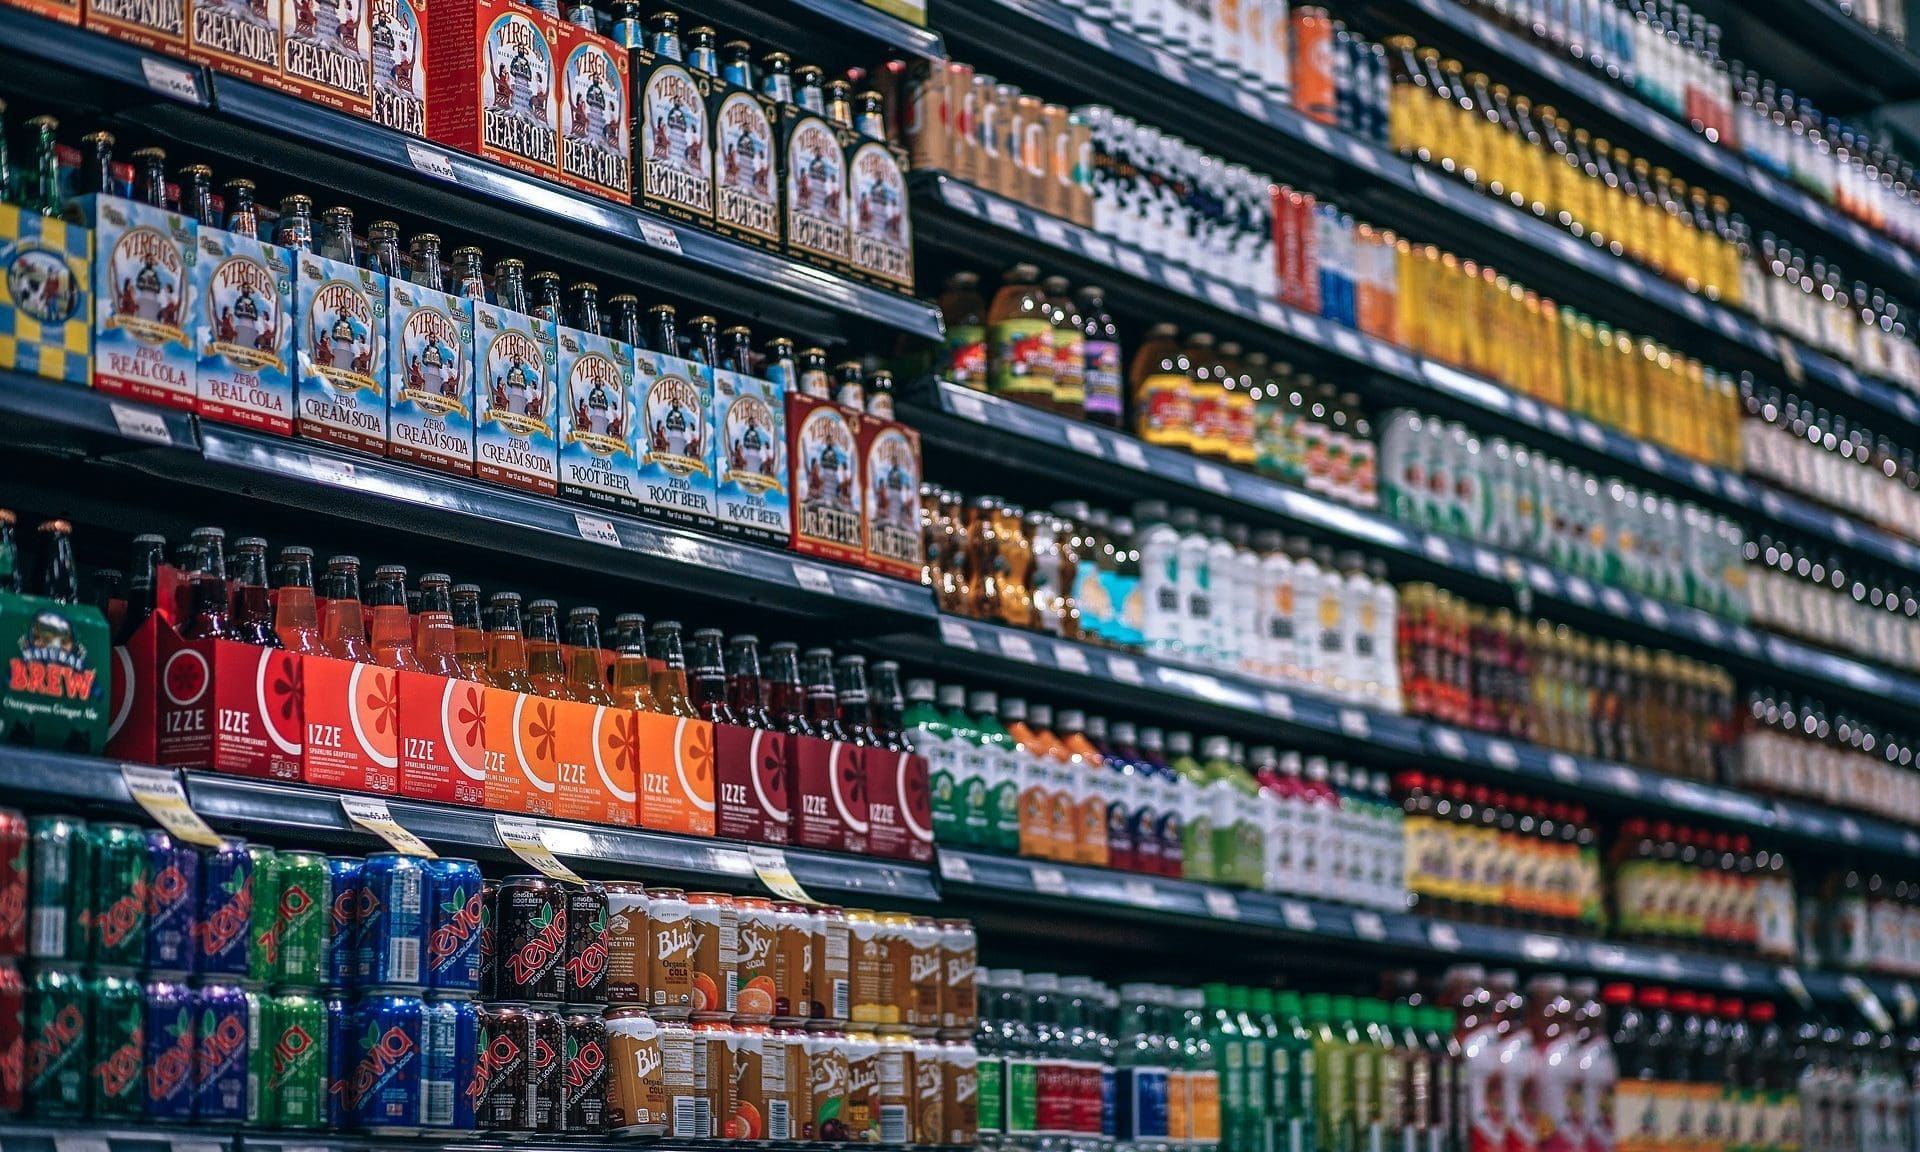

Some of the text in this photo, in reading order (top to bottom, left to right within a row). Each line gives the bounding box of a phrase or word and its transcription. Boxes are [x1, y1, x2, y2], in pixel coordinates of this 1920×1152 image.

[484, 109, 557, 166] REAL COLA
[563, 138, 628, 192] REAL COLA
[121, 231, 177, 273] VIRGIL'S
[220, 261, 273, 301] VIRGIL'S
[319, 285, 369, 325] VIRGIL'S
[410, 312, 455, 350] VIRGIL'S
[136, 345, 163, 364] ZERO
[495, 334, 540, 371] VIRGIL'S
[108, 352, 187, 387] REAL COLA
[234, 371, 259, 388] ZERO
[577, 357, 619, 392] VIRGIL'S
[208, 379, 283, 412] REAL COLA
[333, 393, 357, 410] ZERO
[653, 380, 698, 413] VIRGIL'S
[305, 398, 381, 433] CREAM SODA
[423, 417, 446, 433] ZERO
[396, 423, 468, 455] CREAM SODA
[508, 437, 530, 452] ZERO
[482, 442, 553, 474] CREAM SODA
[591, 456, 612, 471] ZERO
[569, 464, 633, 495] ROOT BEER
[668, 477, 690, 490] ZERO
[647, 485, 711, 514] ROOT BEER
[726, 502, 785, 530] ROOT BEER
[597, 530, 618, 542] $4.99
[10, 657, 94, 701] BREW
[52, 702, 82, 720] Ginger
[166, 709, 205, 733] IZZE
[219, 708, 250, 734] IZZE
[308, 723, 342, 748] IZZE
[404, 737, 434, 761] IZZE
[484, 750, 506, 773] ZZE
[557, 762, 587, 784] IZZE
[643, 772, 670, 795] IZZE
[721, 783, 747, 804] IZZE
[803, 794, 828, 816] IZZE
[662, 960, 688, 969] Organic
[668, 968, 688, 977] COLA
[744, 959, 766, 970] SODA
[528, 969, 546, 986] ZERO
[588, 972, 603, 989] ZERO
[504, 1057, 521, 1076] SODA
[543, 1061, 557, 1080] SODA
